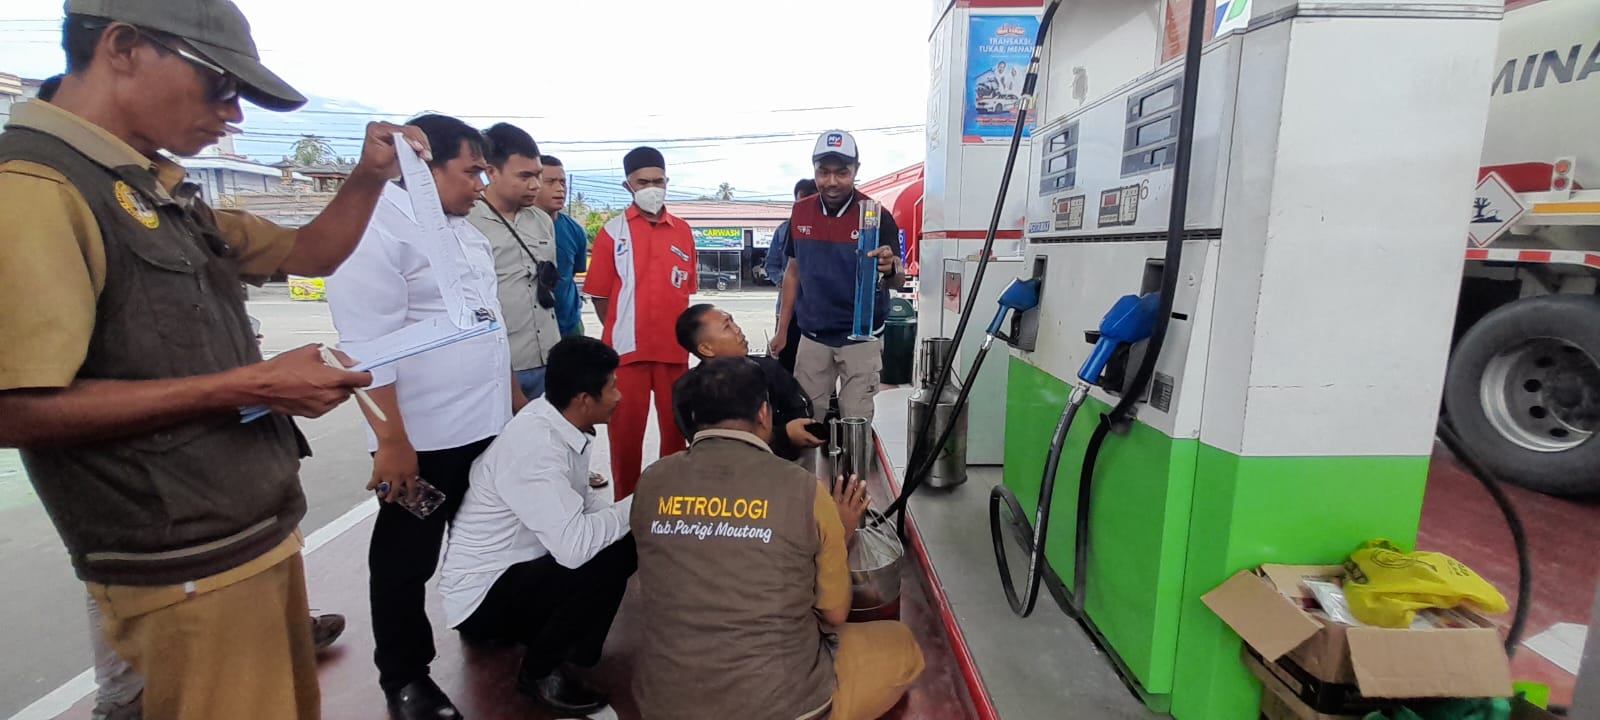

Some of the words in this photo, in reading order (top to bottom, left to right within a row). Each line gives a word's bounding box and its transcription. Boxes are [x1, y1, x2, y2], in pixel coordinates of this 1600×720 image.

[1140, 179, 1149, 200] 6
[702, 229, 740, 237] CARWASH
[658, 496, 768, 519] METROLOGI
[714, 521, 772, 543] Moutong
